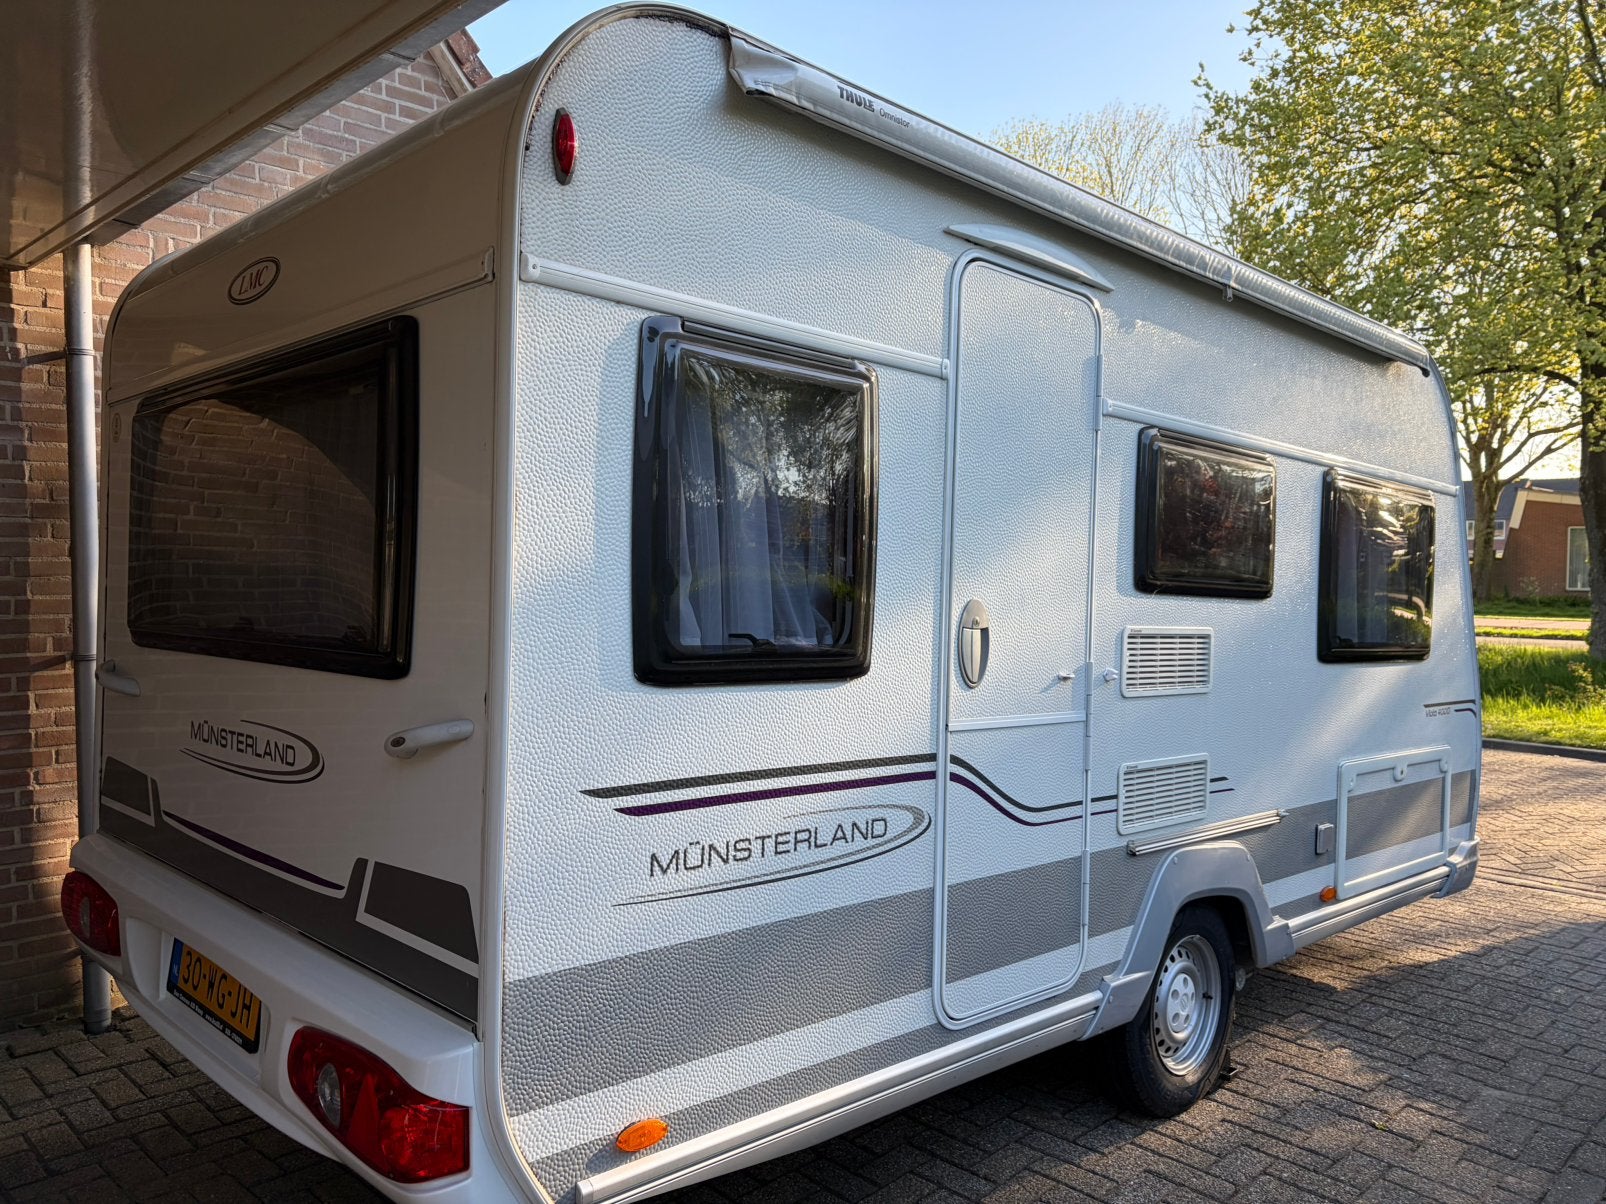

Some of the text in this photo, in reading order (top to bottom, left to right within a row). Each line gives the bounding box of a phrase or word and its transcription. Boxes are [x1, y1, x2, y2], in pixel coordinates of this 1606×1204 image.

[836, 84, 911, 128] THULE Omnistor
[238, 265, 269, 296] LMC
[190, 719, 297, 767] MÜNSTERLAND
[648, 816, 889, 878] MÜNSTERLAND
[181, 949, 254, 1030] 30-WG-JH
